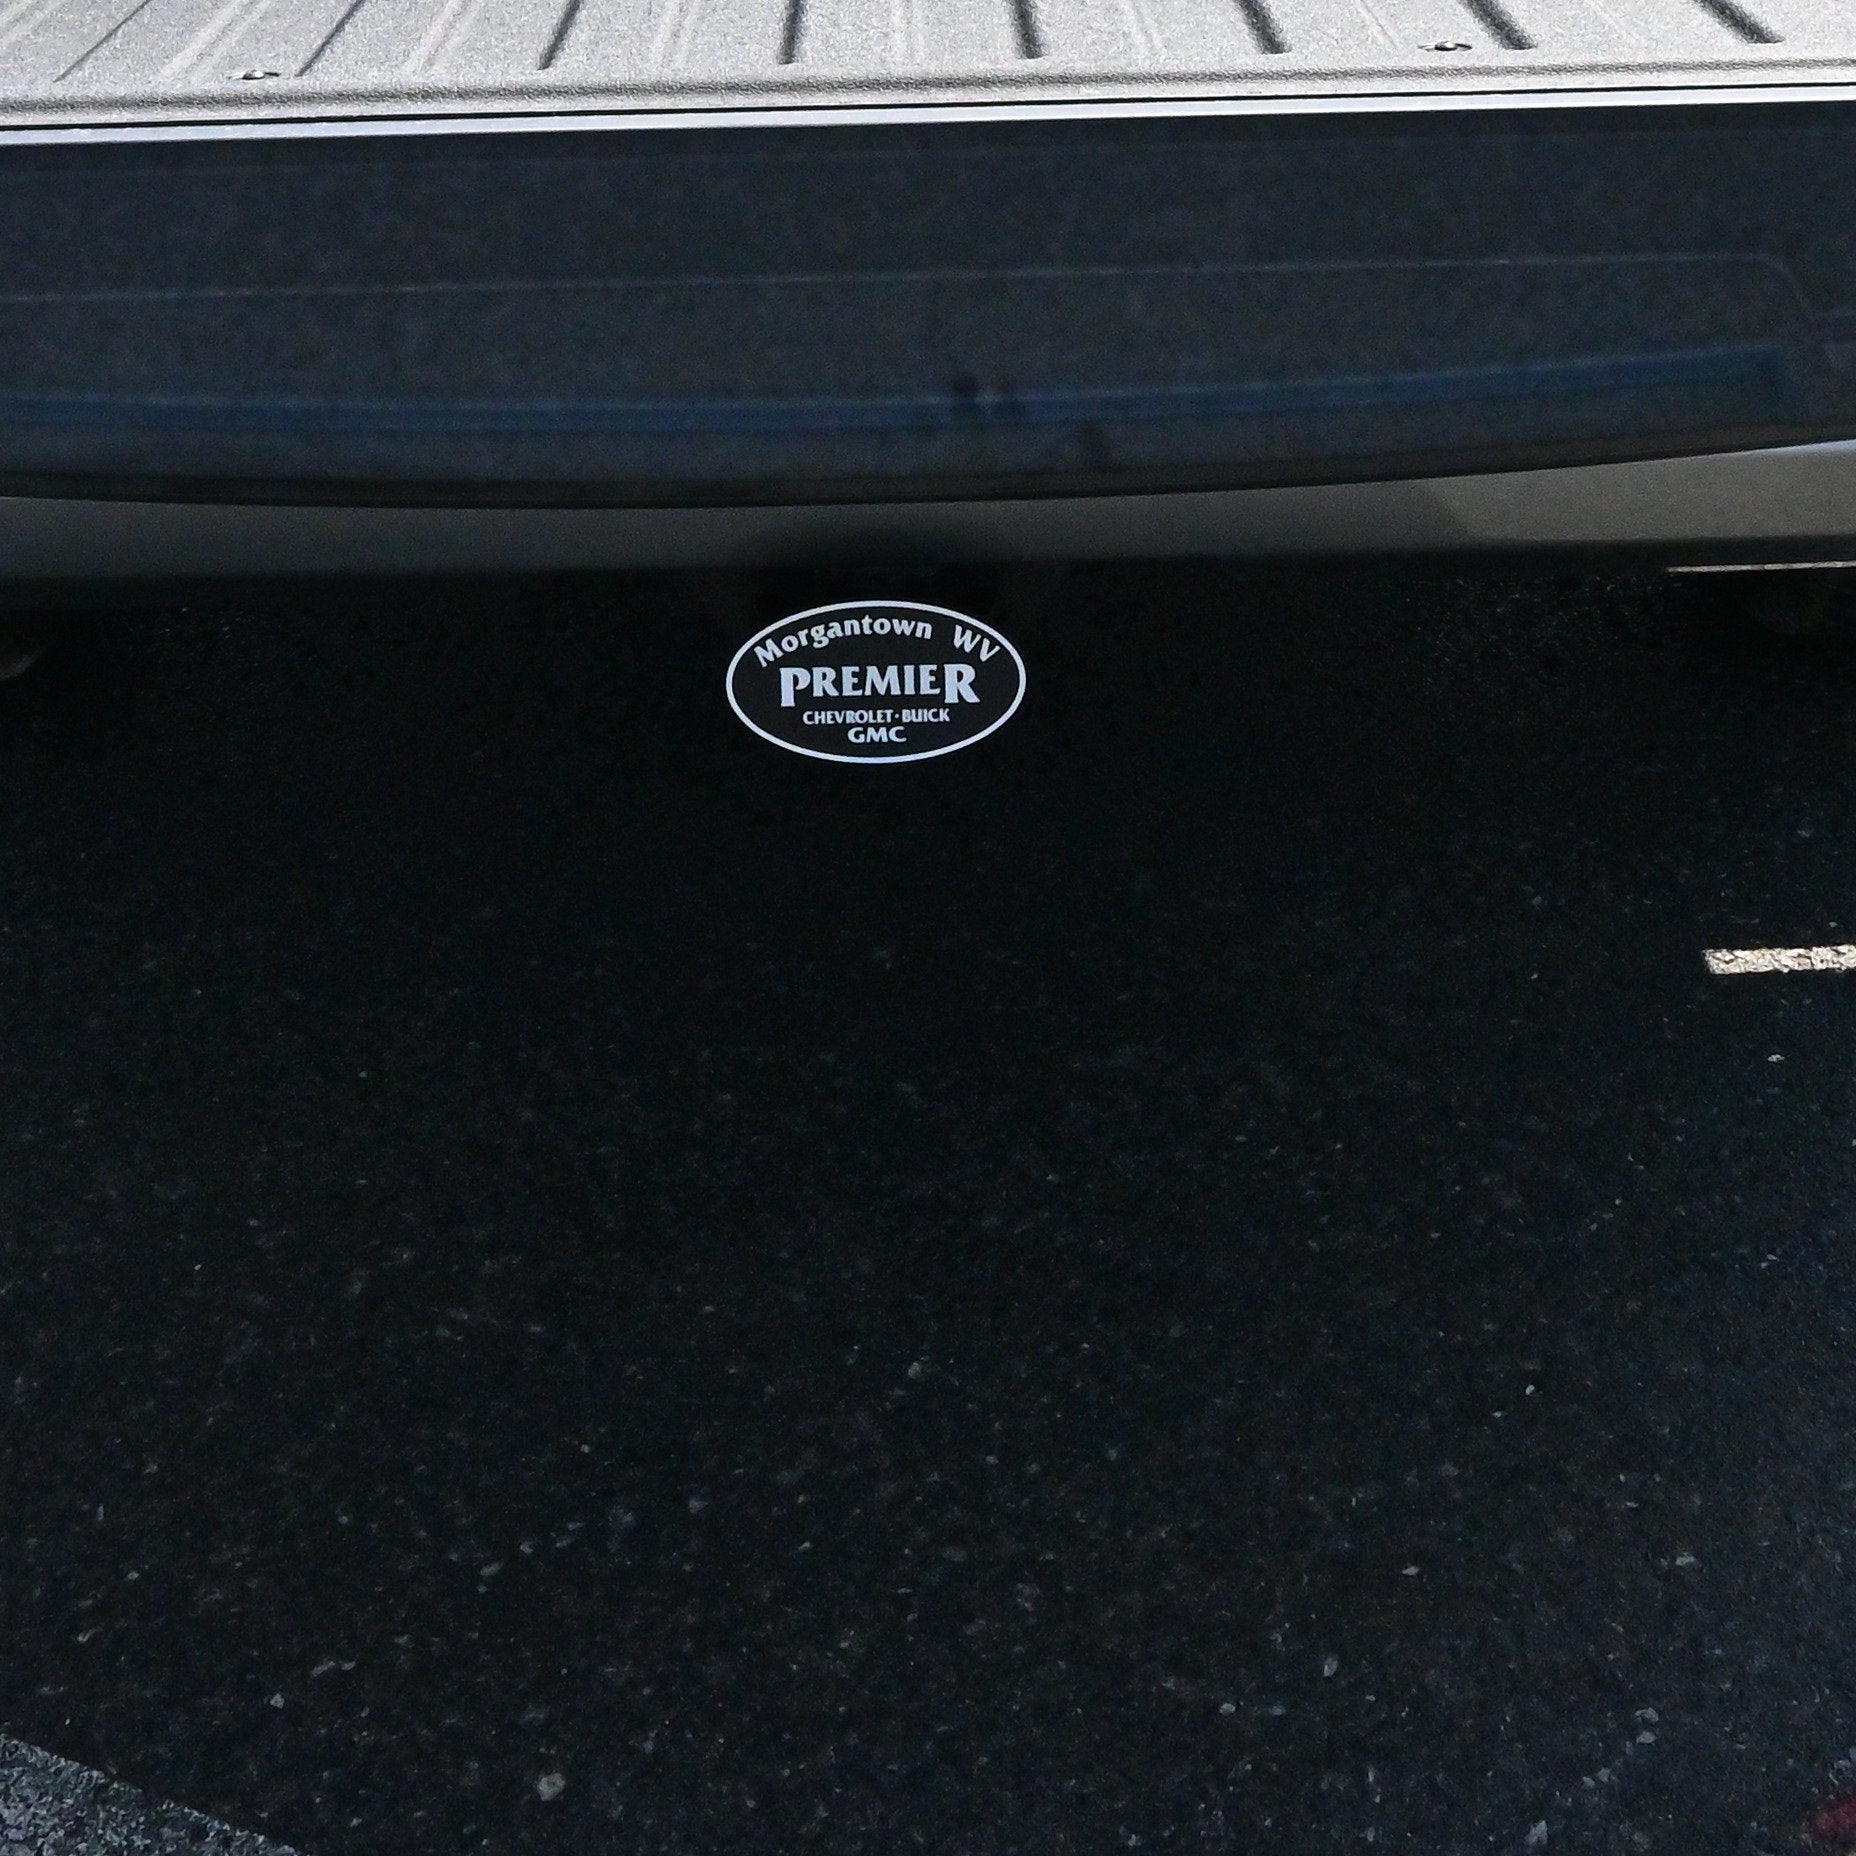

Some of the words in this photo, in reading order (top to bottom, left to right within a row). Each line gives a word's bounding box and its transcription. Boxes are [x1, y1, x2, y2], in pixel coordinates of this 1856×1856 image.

[753, 614, 932, 668] Morgantown
[953, 624, 1002, 663] WV
[779, 663, 980, 707] PREMIER
[902, 708, 950, 723] BUICK
[847, 726, 907, 744] GMC
